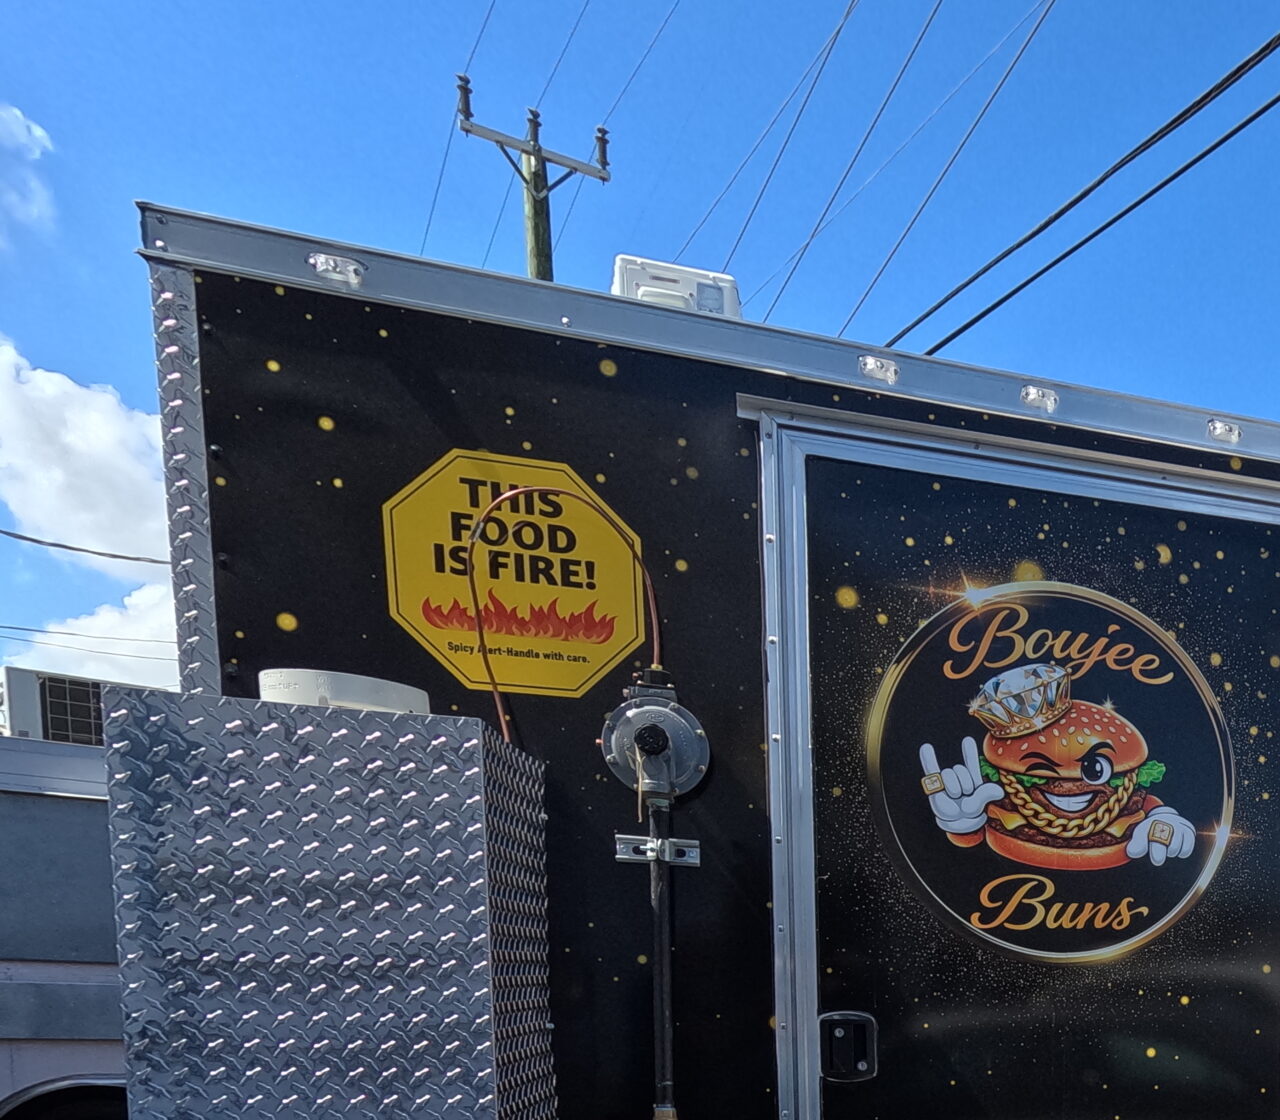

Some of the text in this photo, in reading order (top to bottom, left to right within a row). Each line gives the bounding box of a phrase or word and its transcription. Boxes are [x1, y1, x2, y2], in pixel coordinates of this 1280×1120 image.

[459, 477, 563, 518] THIS
[451, 511, 577, 554] FOOD
[433, 543, 597, 590] IS FIRE!
[447, 641, 591, 664] Spicy ert-Handle with care.
[942, 604, 1175, 685] Boujee
[970, 873, 1149, 931] Buns
